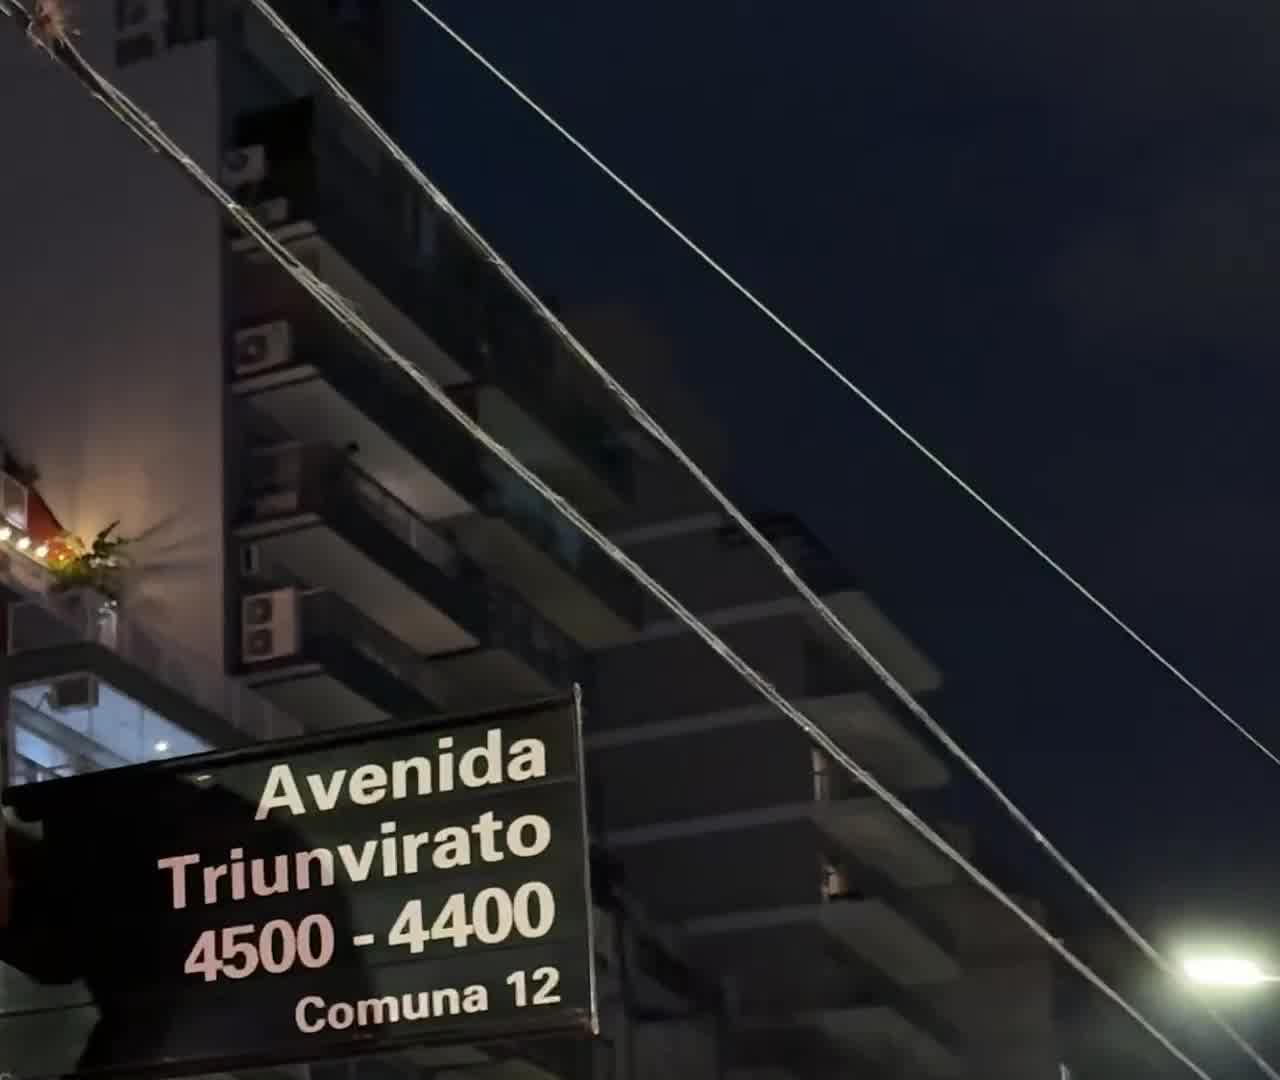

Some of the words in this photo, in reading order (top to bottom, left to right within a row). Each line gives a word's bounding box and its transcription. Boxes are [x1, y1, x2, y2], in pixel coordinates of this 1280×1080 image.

[254, 727, 547, 821] Avenida
[157, 810, 552, 909] Triunvirato
[183, 913, 335, 982] 4500
[387, 880, 556, 954] 4400
[295, 983, 489, 1034] Comuna
[505, 965, 561, 1008] 12
